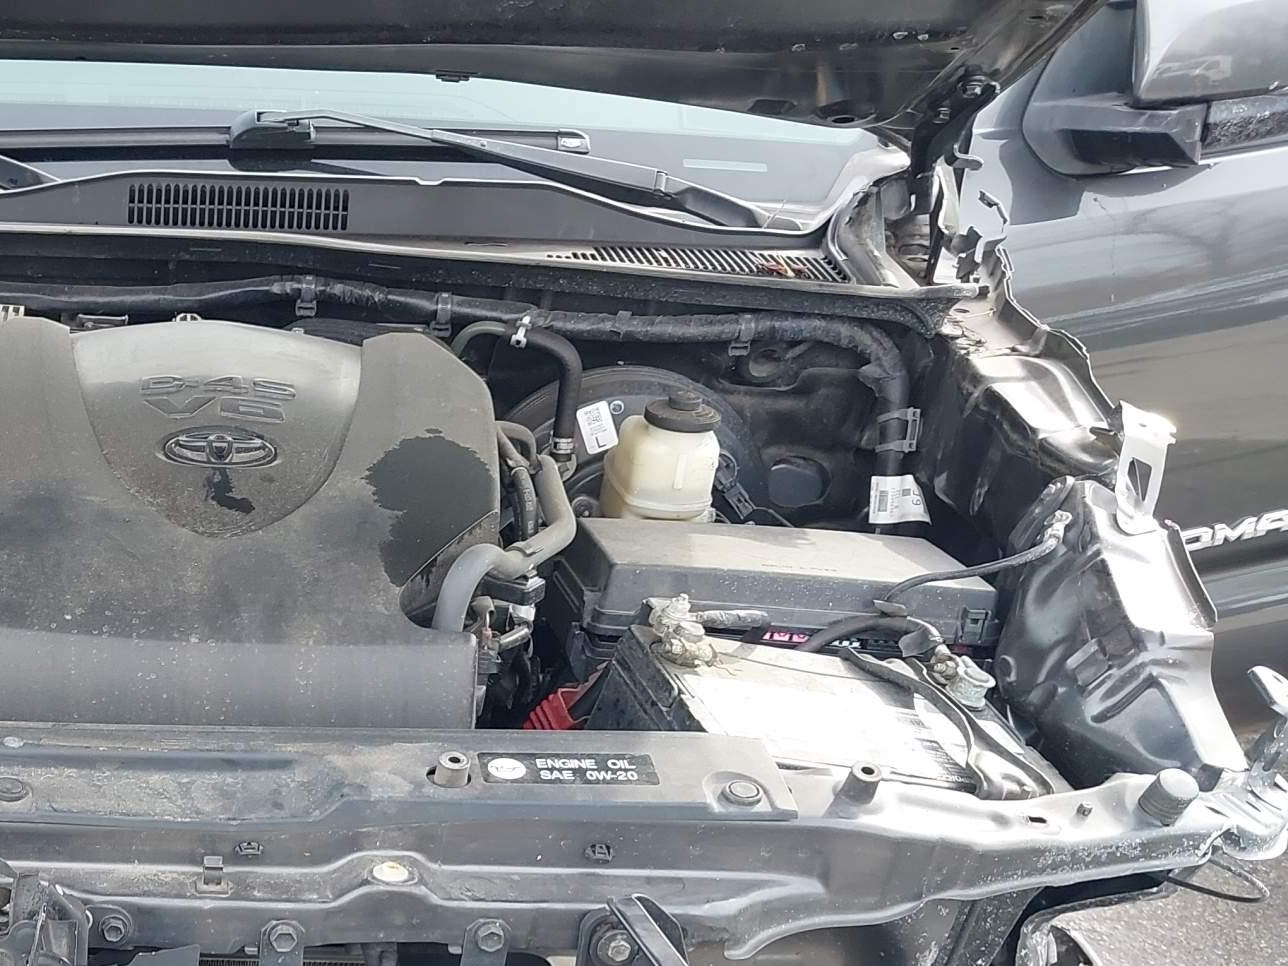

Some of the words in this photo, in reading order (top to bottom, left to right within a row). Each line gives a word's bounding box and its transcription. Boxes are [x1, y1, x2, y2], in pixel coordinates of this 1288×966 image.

[143, 395, 286, 424] V6
[535, 758, 598, 769] ENGINE
[607, 759, 637, 770] OIL
[539, 770, 576, 780] SAE
[585, 770, 639, 781] 0W-20
